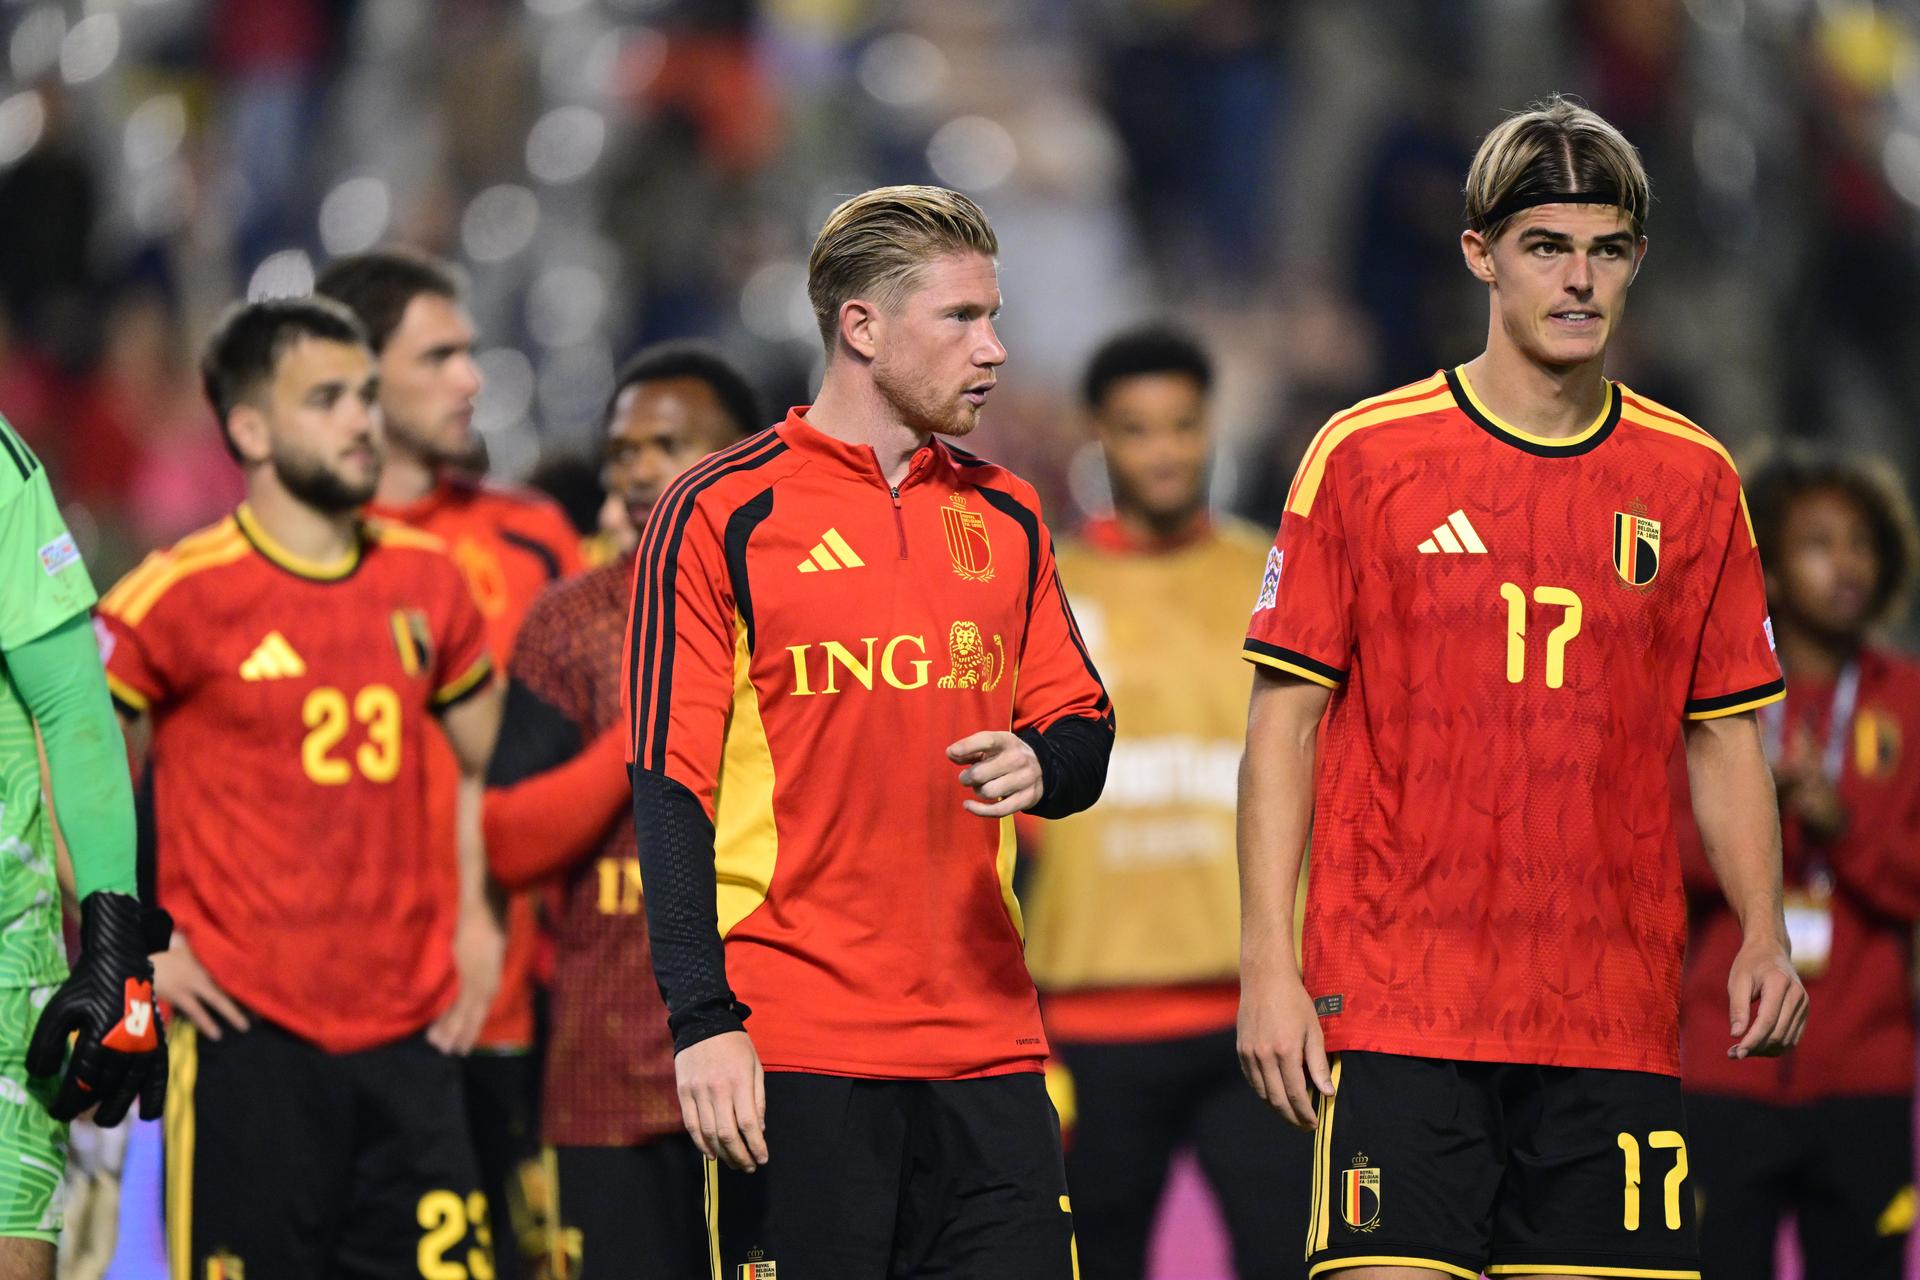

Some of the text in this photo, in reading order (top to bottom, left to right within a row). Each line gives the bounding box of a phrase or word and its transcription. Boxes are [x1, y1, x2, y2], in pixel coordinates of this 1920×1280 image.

[785, 634, 933, 696] ING
[1500, 582, 1583, 689] 17
[302, 684, 402, 785] 23
[1617, 1130, 1689, 1231] 17
